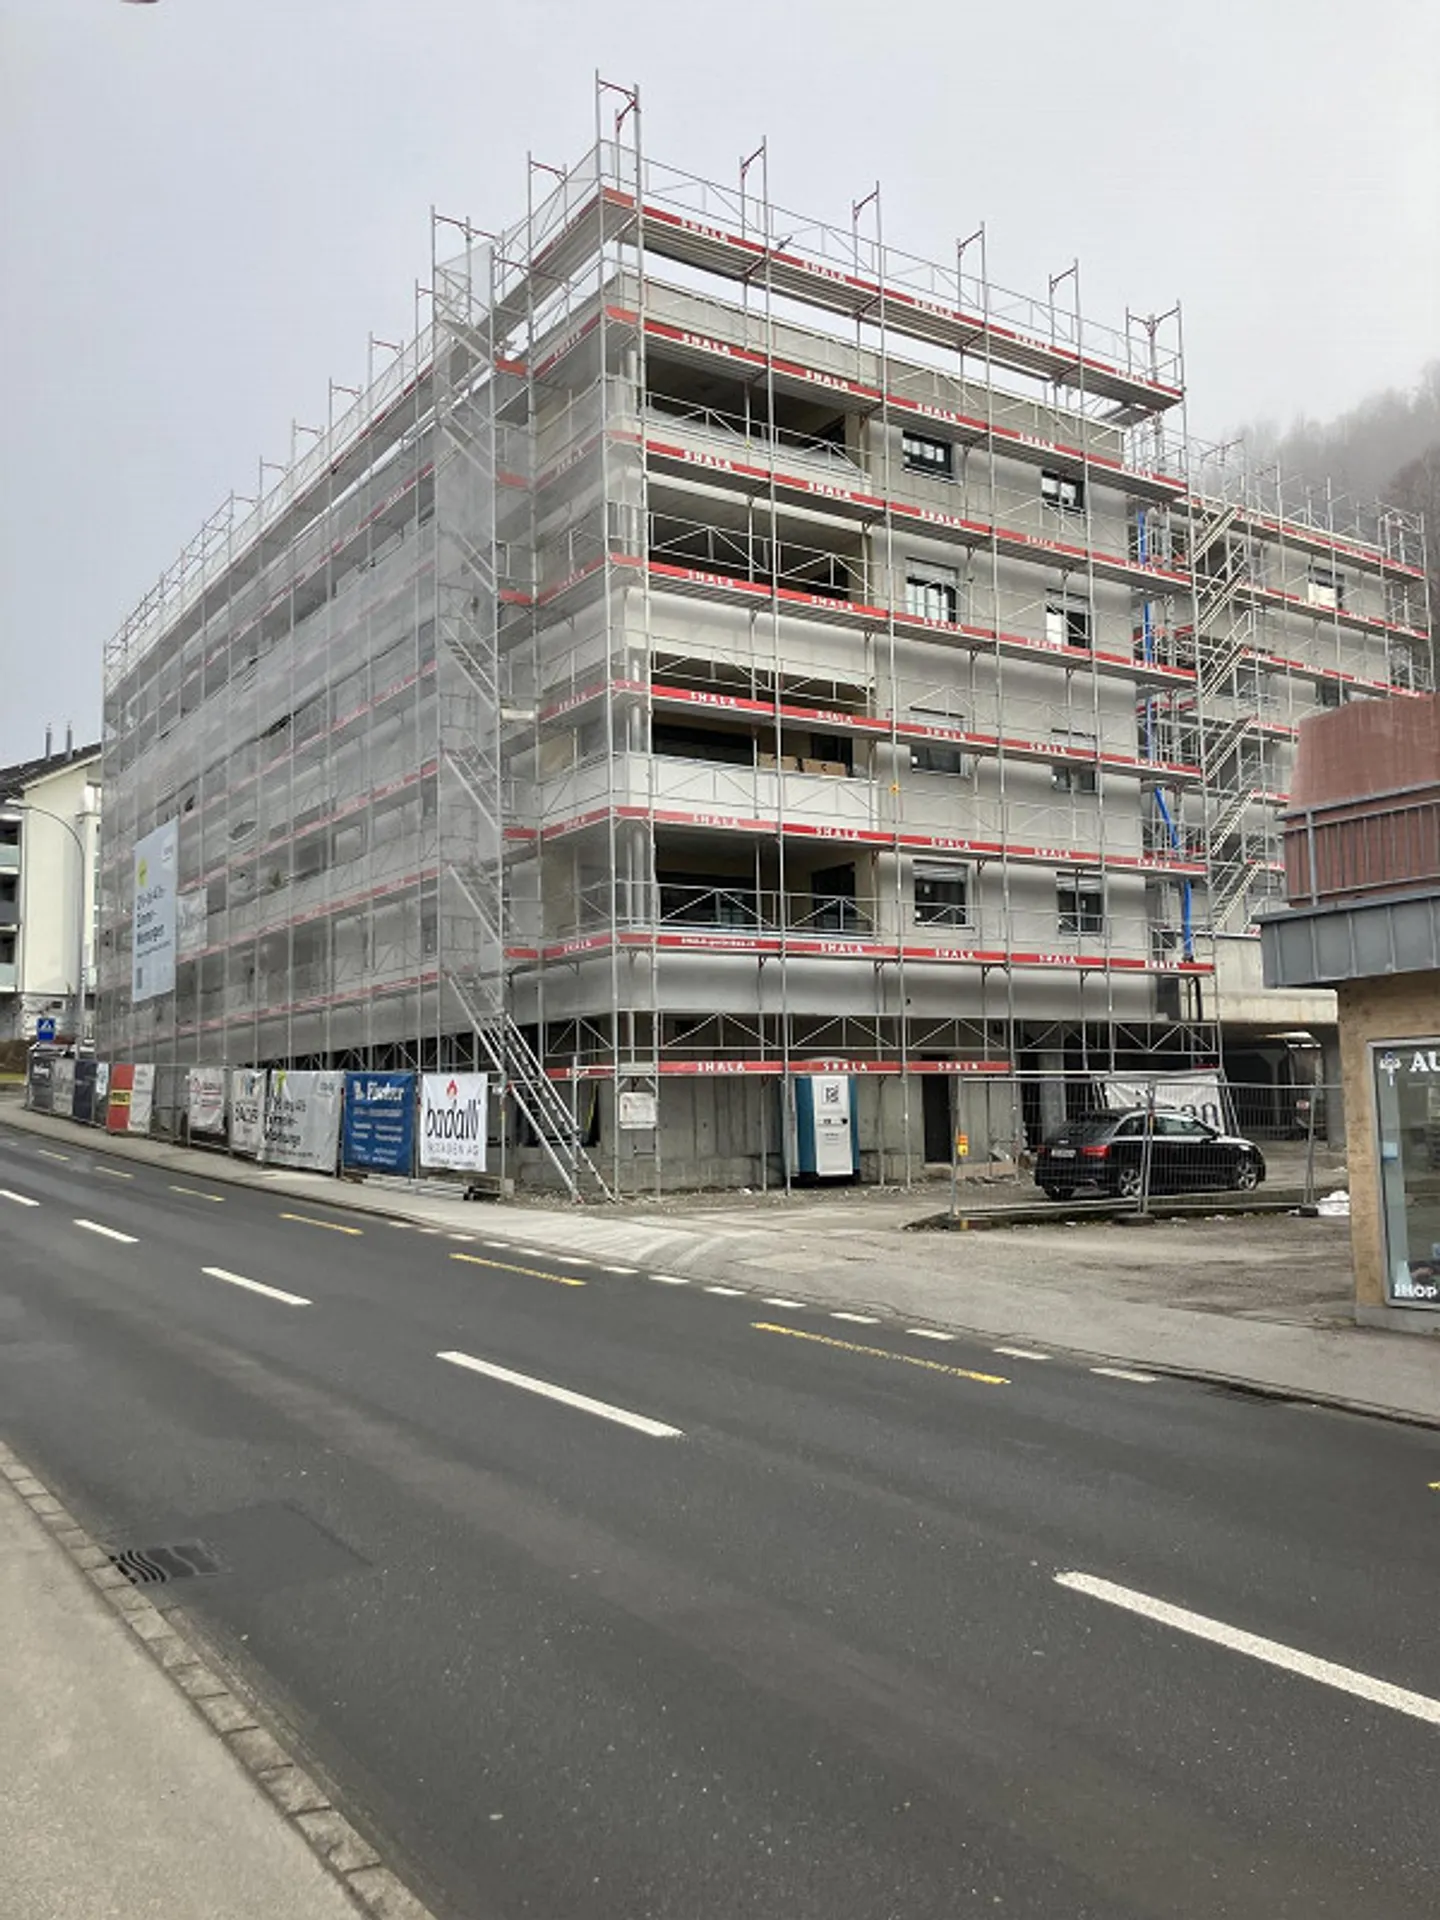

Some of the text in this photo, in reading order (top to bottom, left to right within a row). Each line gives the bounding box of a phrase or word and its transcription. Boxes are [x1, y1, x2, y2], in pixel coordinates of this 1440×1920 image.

[683, 450, 733, 471] SHALA
[688, 570, 734, 588] SHALA
[691, 692, 736, 706] SHALA
[694, 814, 739, 828] SHALA
[815, 826, 859, 839] SHALA
[931, 838, 970, 850] SHALA
[820, 943, 863, 953] SHALA
[697, 1062, 745, 1072] SHALA
[823, 1062, 867, 1072] SHALA
